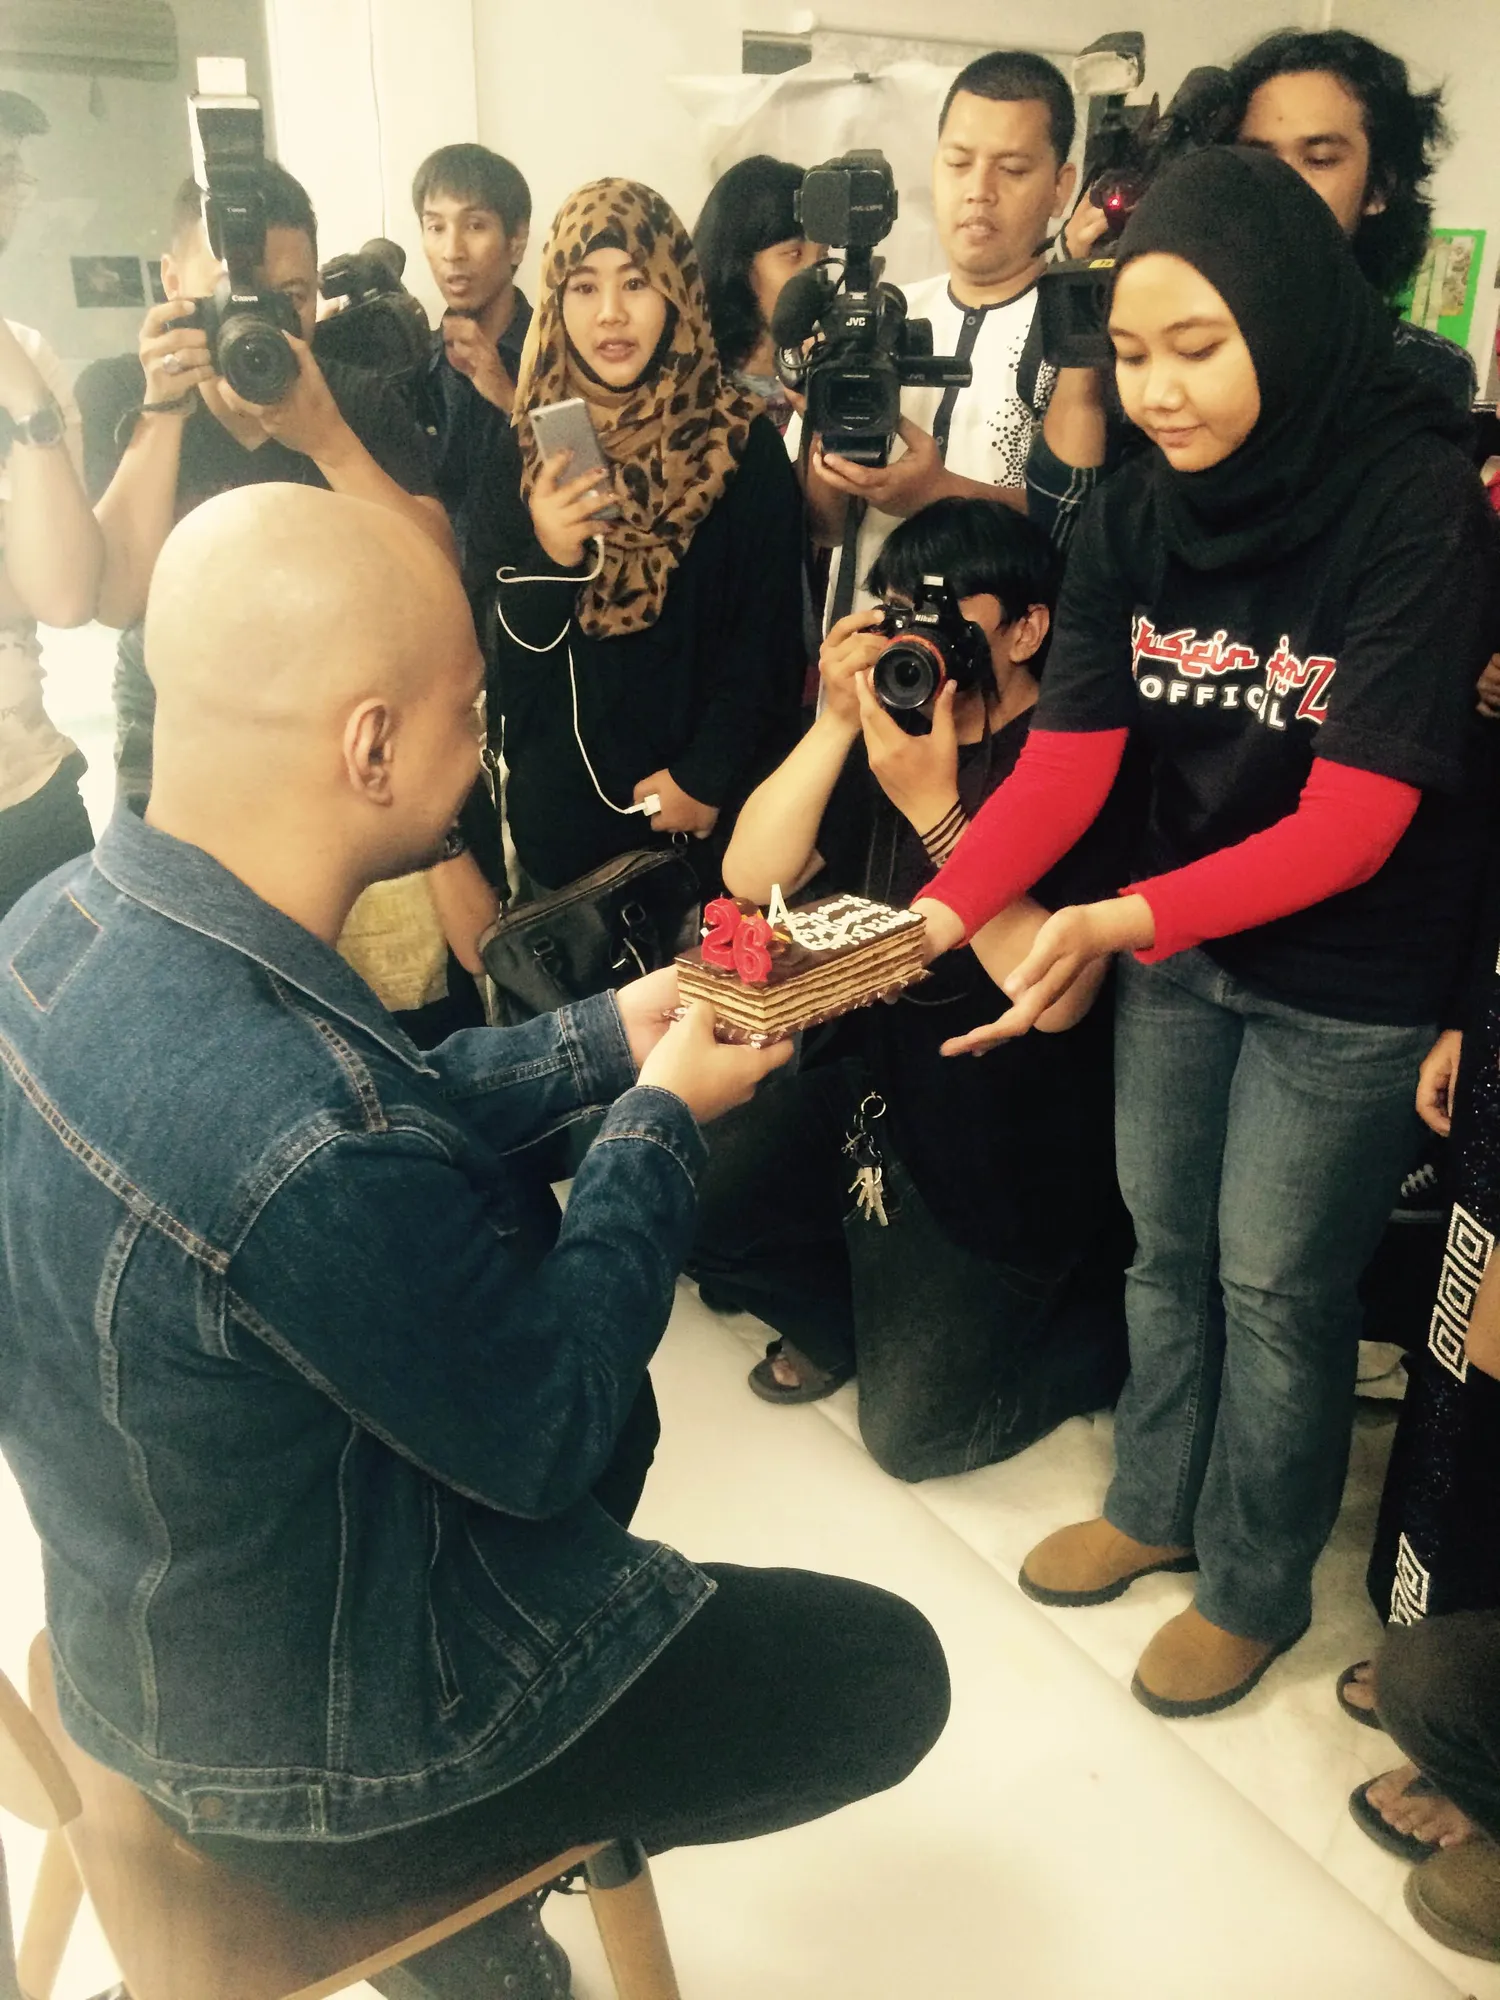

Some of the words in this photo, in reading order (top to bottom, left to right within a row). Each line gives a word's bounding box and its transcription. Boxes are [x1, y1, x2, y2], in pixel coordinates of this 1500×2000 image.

[231, 294, 259, 302] Canon
[845, 316, 866, 327] JVC
[914, 614, 939, 623] Nikon
